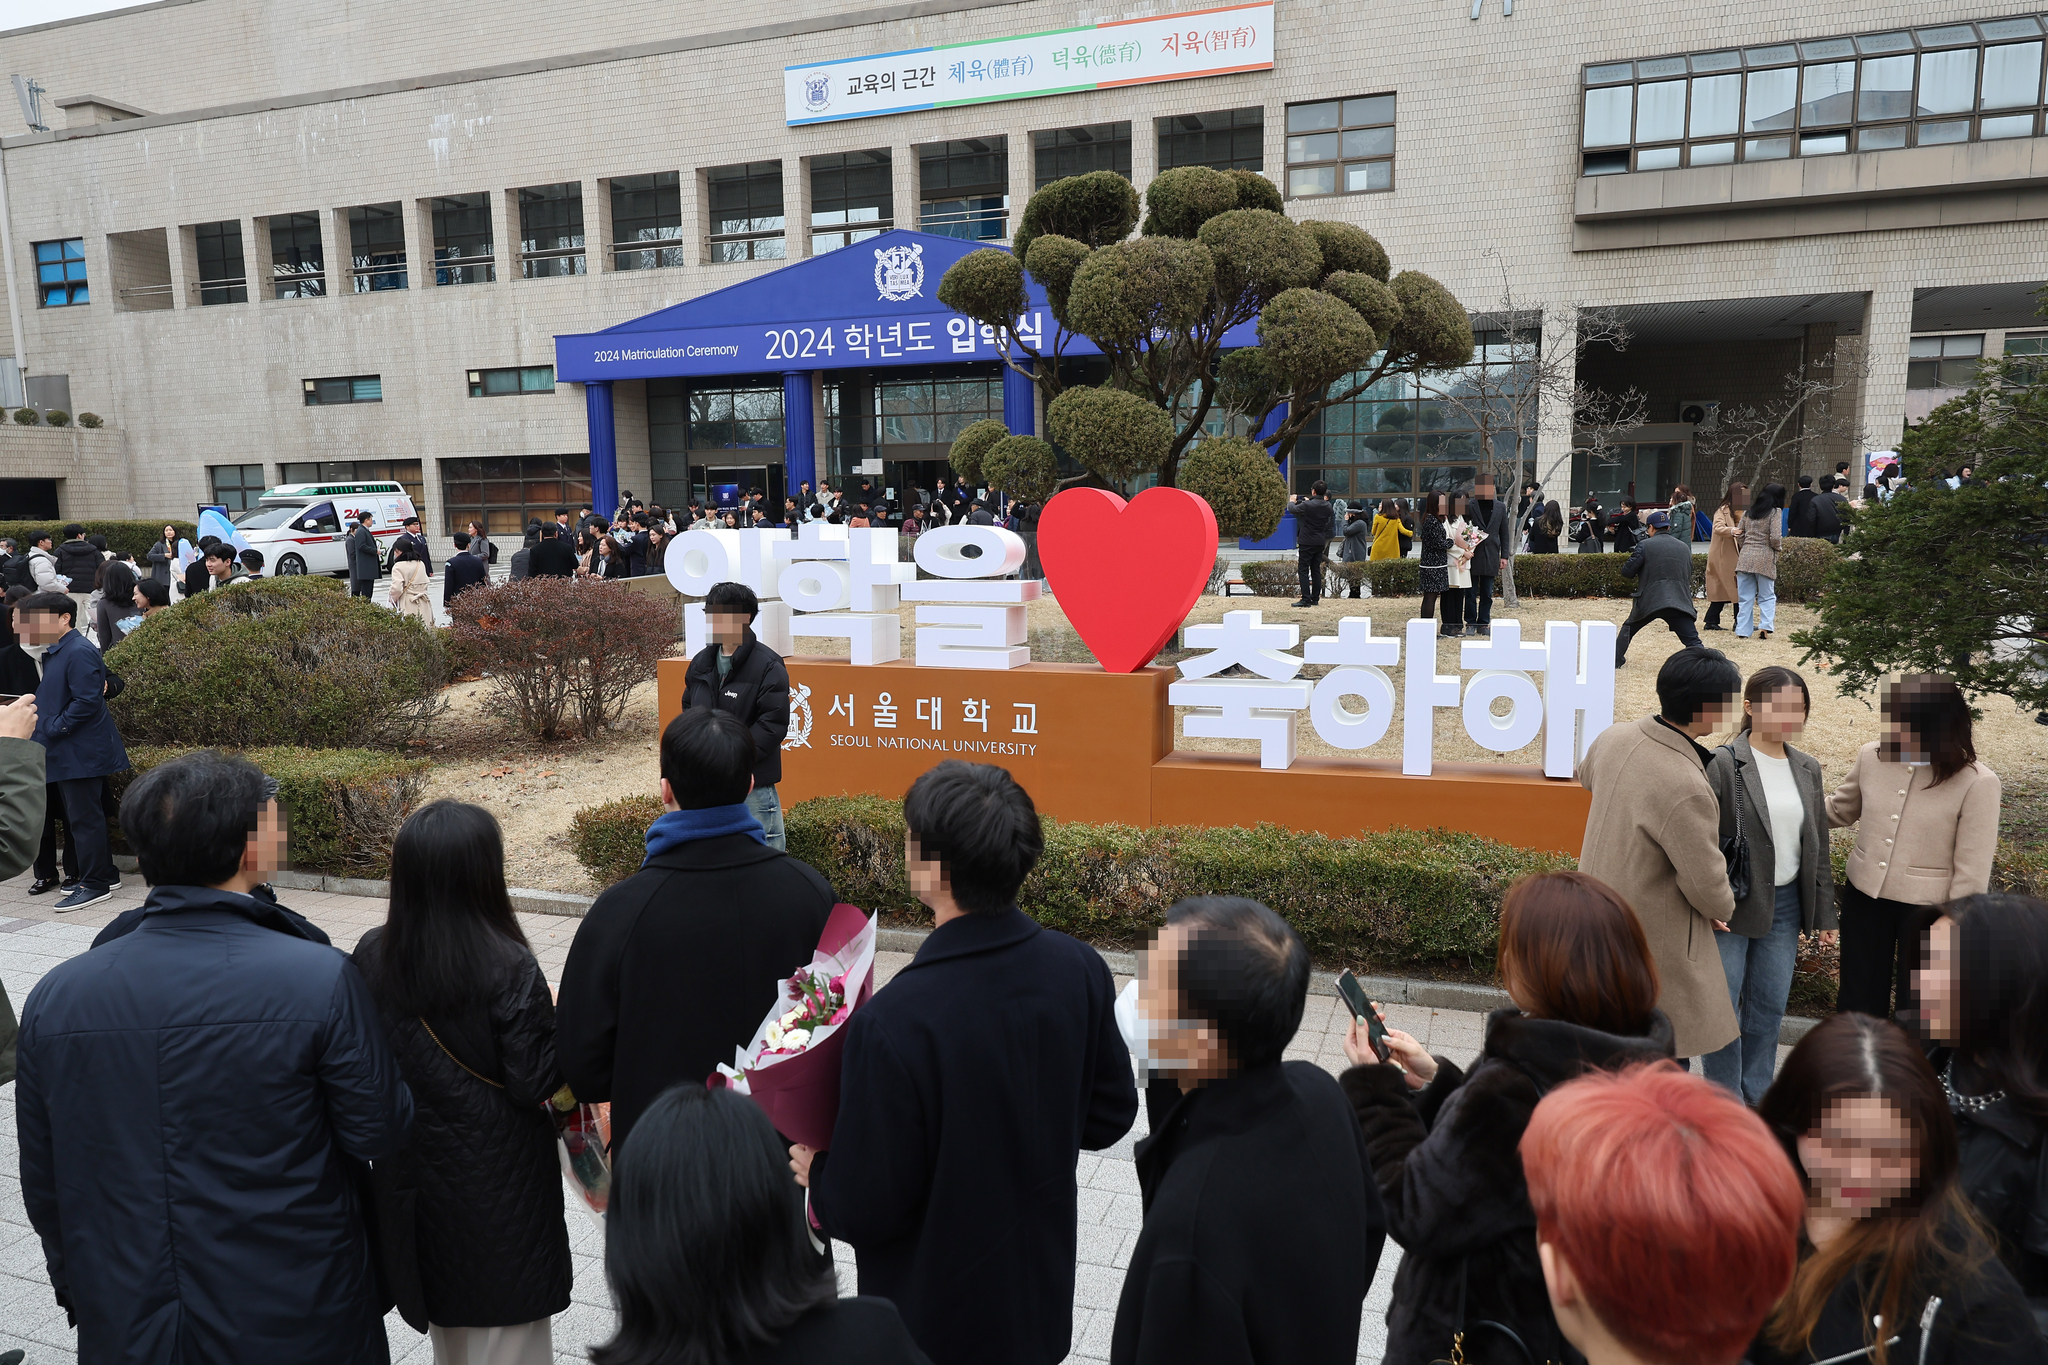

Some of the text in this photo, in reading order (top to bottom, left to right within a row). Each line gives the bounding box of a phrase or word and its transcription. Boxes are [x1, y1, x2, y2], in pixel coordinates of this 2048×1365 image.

[847, 71, 896, 95] 교육의
[902, 66, 936, 90] 근간
[947, 54, 1034, 84] 체육(體育)
[1051, 39, 1142, 71] 덕육(德育)
[1160, 25, 1256, 57] 지육(智育)
[594, 345, 739, 363] 2024 Matriculation Ceremony
[764, 326, 836, 360] 2024
[844, 321, 936, 359] 학년도
[1169, 609, 1617, 778] 축하해
[830, 734, 1037, 756] SEOUL NATIONAL UNIVERSITY
